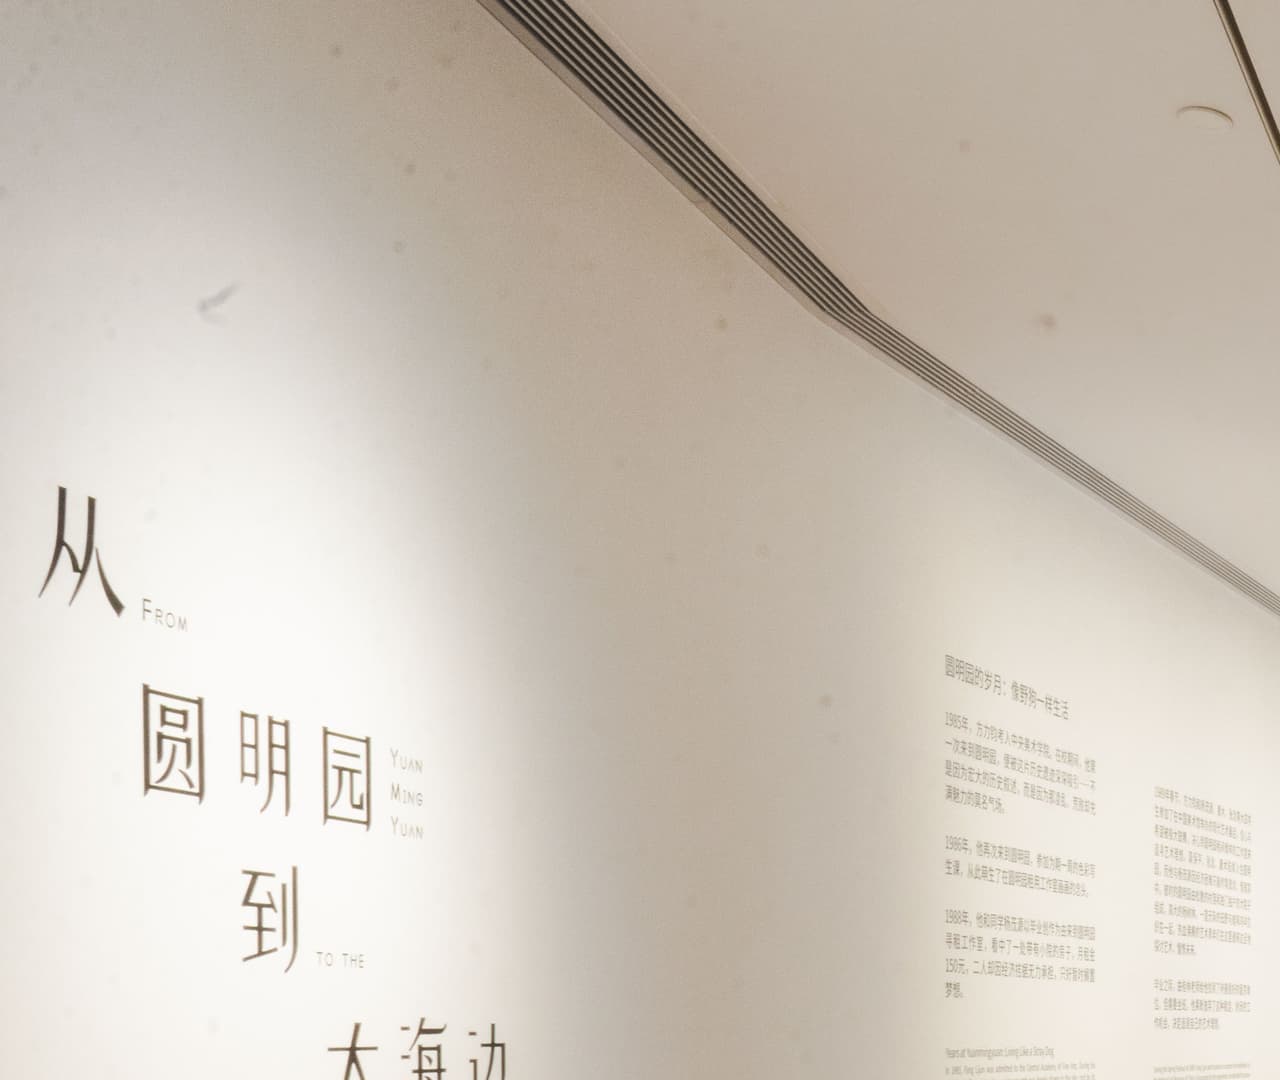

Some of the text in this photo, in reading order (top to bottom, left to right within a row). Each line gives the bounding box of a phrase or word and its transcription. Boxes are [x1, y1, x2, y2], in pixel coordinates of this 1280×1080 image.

[38, 486, 125, 617] 从
[142, 683, 372, 832] 圆明园
[242, 866, 299, 973] 到
